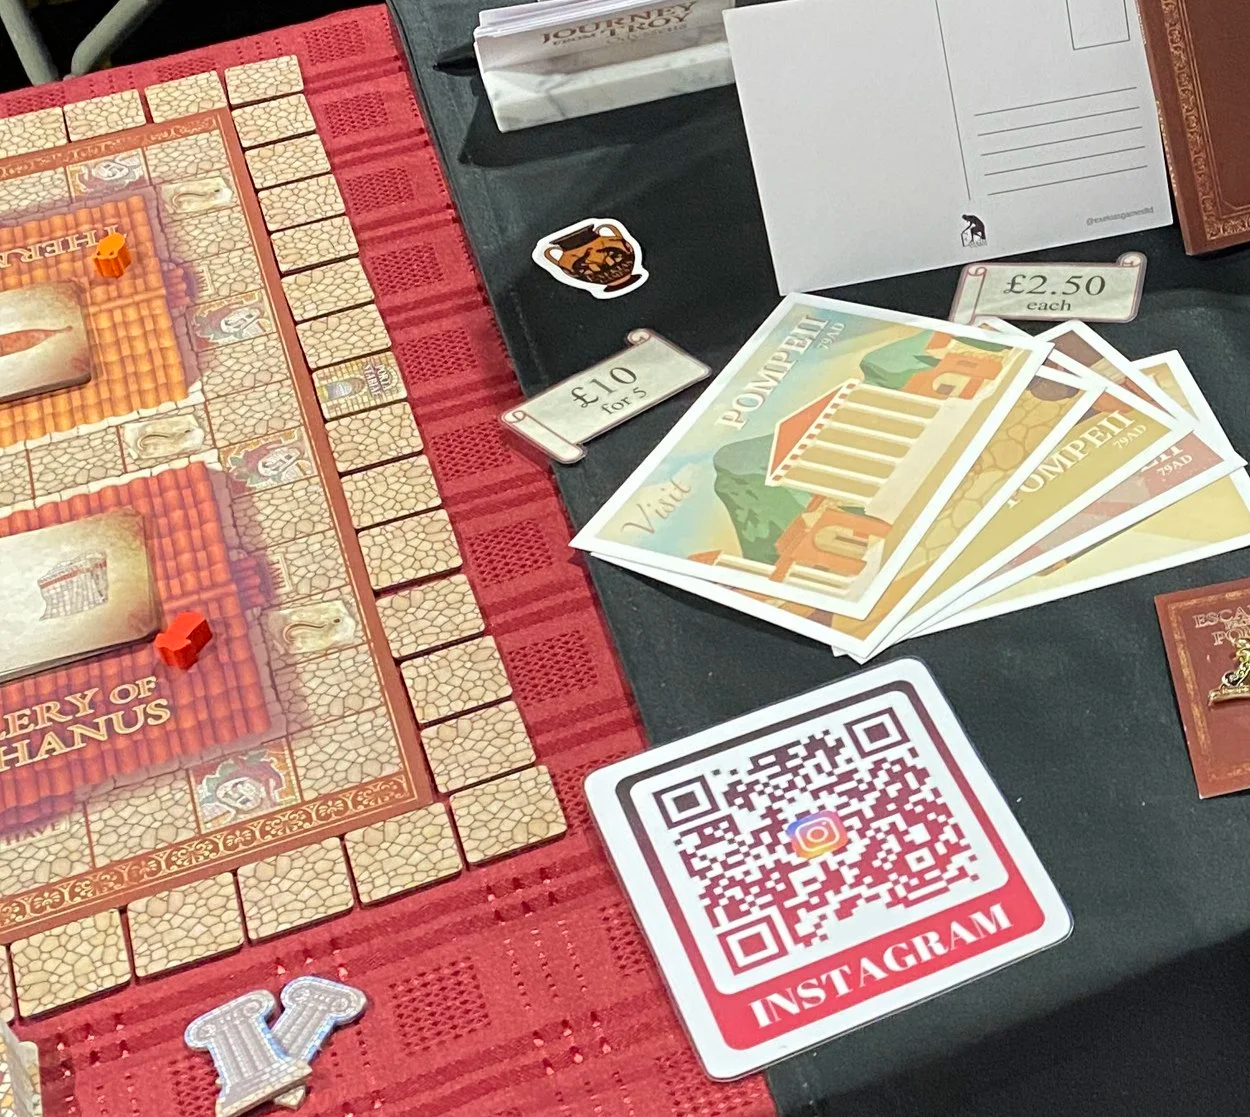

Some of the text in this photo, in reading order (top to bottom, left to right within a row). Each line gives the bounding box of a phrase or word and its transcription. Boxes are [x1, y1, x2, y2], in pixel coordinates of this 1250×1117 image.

[543, 0, 697, 45] JOURNEY
[1003, 273, 1106, 298] £2.50
[1026, 298, 1072, 312] each
[818, 319, 846, 351] 79AD
[569, 363, 638, 410] £10
[713, 315, 829, 432] POMPEII
[600, 385, 648, 418] for 5
[1113, 423, 1147, 449] 79AD
[1157, 453, 1194, 477] 79AD
[621, 476, 693, 536] Visit
[0, 676, 157, 741] ERY OF
[748, 902, 1014, 1029] INSTAGRAM
